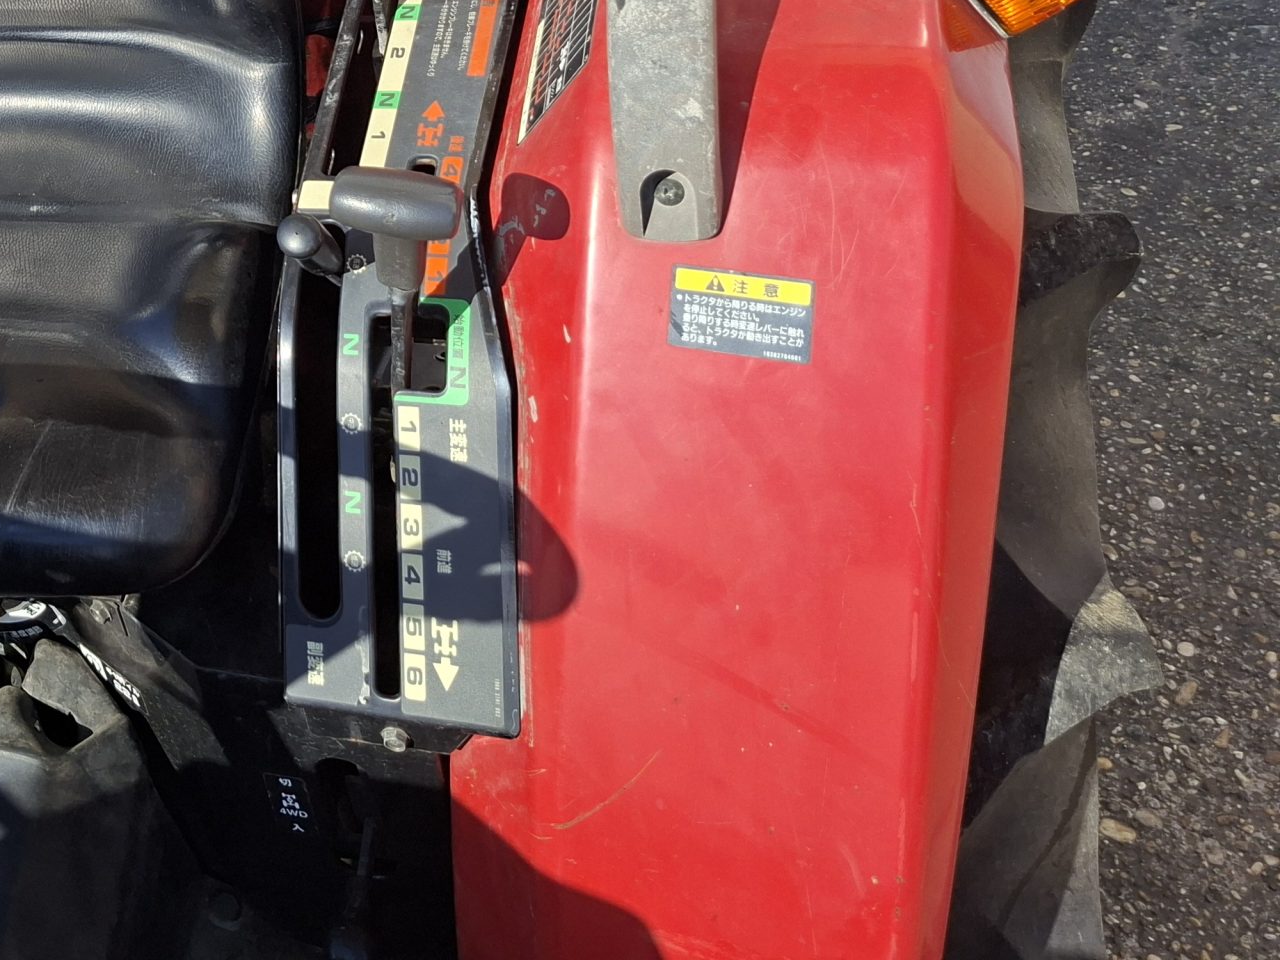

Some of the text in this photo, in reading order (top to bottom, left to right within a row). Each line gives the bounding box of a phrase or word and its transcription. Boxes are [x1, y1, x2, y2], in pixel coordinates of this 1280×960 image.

[399, 5, 415, 20] N
[390, 47, 406, 59] 2
[378, 92, 395, 107] N
[370, 130, 385, 140] 1
[442, 165, 458, 178] 4
[427, 270, 443, 283] 1
[732, 278, 780, 298] 注意
[683, 303, 761, 322] を停止してください。
[684, 294, 807, 318] トラクタから降りる時はエンジン
[342, 333, 359, 356] N
[681, 333, 719, 347] あります。
[449, 314, 466, 389] 始動位置 N
[400, 419, 416, 433] 1
[448, 418, 467, 462] 主変速
[402, 467, 418, 486] 2
[344, 490, 361, 514] N
[403, 517, 419, 536] 3
[435, 548, 452, 574] 前進
[404, 564, 420, 584] 4
[405, 616, 421, 635] 5
[306, 640, 324, 686] 副変速
[406, 666, 422, 685] 6
[280, 807, 309, 819] 4WD
[292, 823, 305, 833] 入
